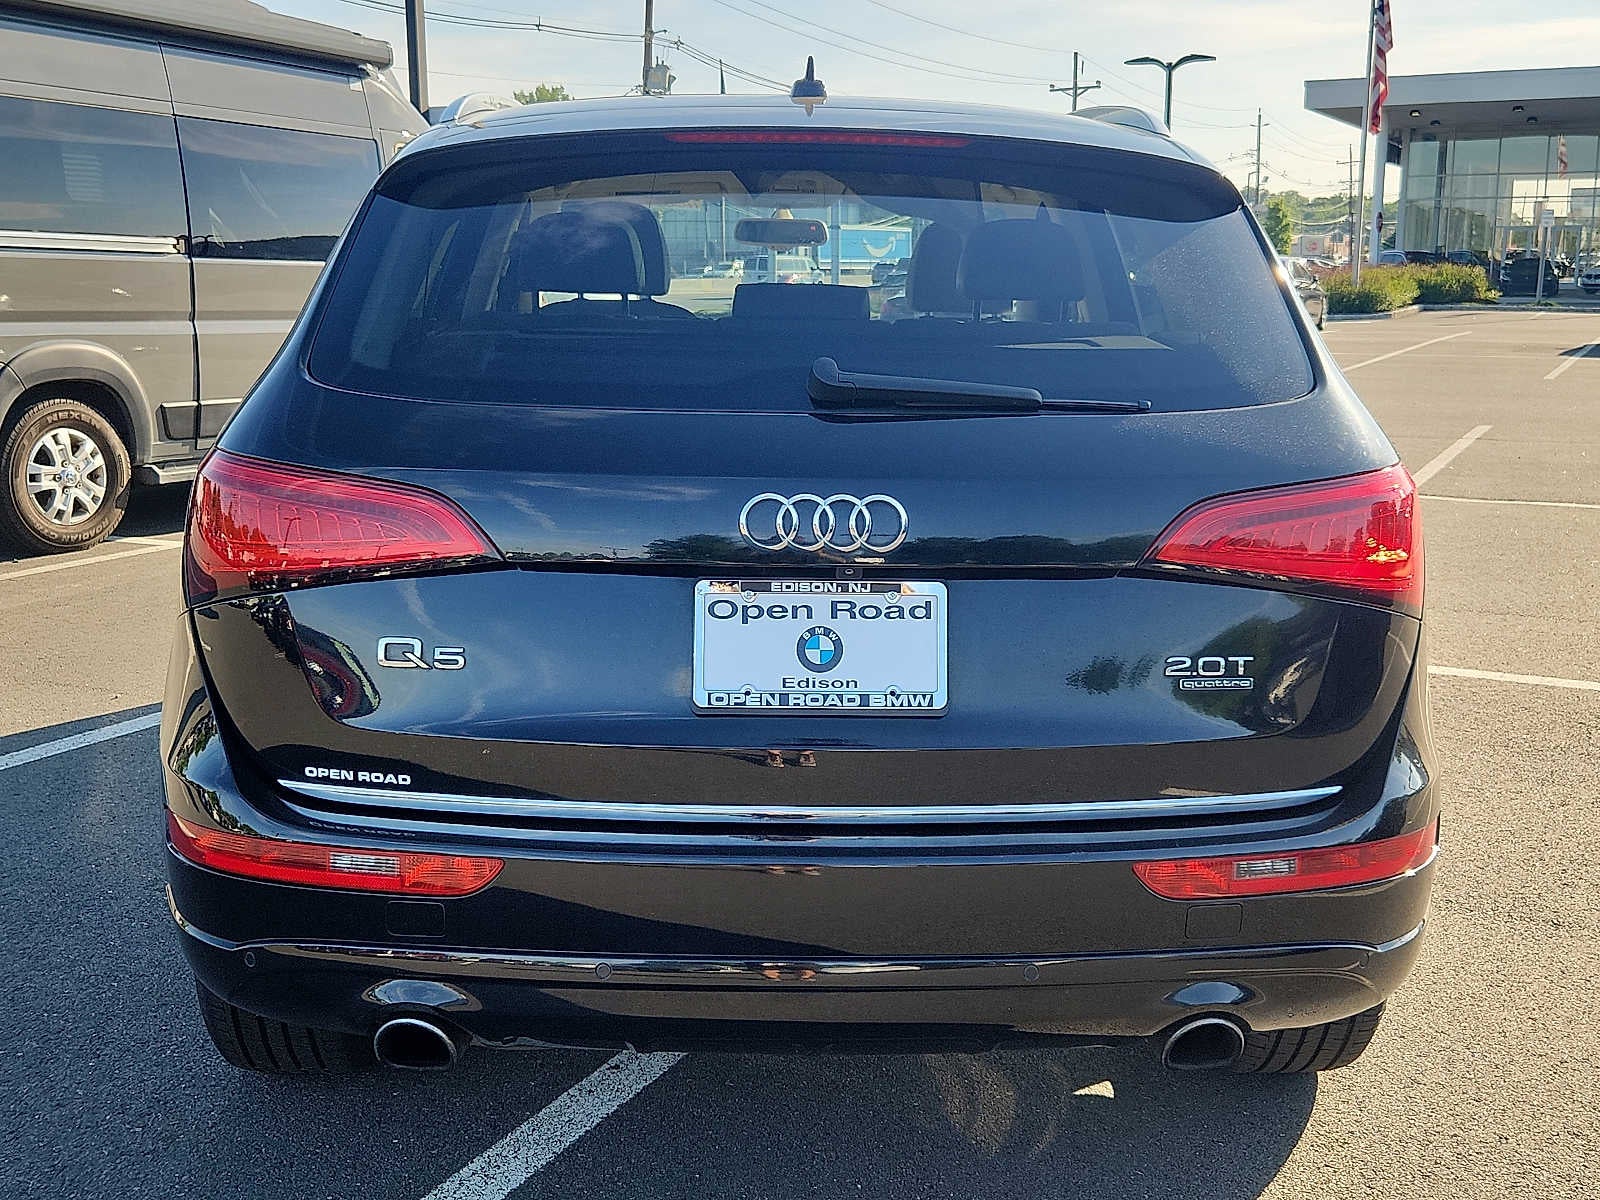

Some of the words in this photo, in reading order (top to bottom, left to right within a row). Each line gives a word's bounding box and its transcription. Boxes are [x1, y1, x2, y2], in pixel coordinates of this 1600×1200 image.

[770, 582, 842, 593] EDISON,
[848, 583, 871, 593] NJ
[707, 599, 813, 624] Open
[830, 600, 932, 620] Road
[802, 627, 839, 641] BMW
[377, 636, 466, 669] Q5
[1165, 656, 1255, 676] 2.0T
[782, 677, 858, 689] Edison
[1183, 680, 1250, 688] quattro
[710, 693, 780, 706] OPEN
[788, 694, 861, 706] ROAD
[868, 694, 932, 707] BMW
[304, 766, 354, 781] OPEN
[357, 771, 412, 785] ROAD
